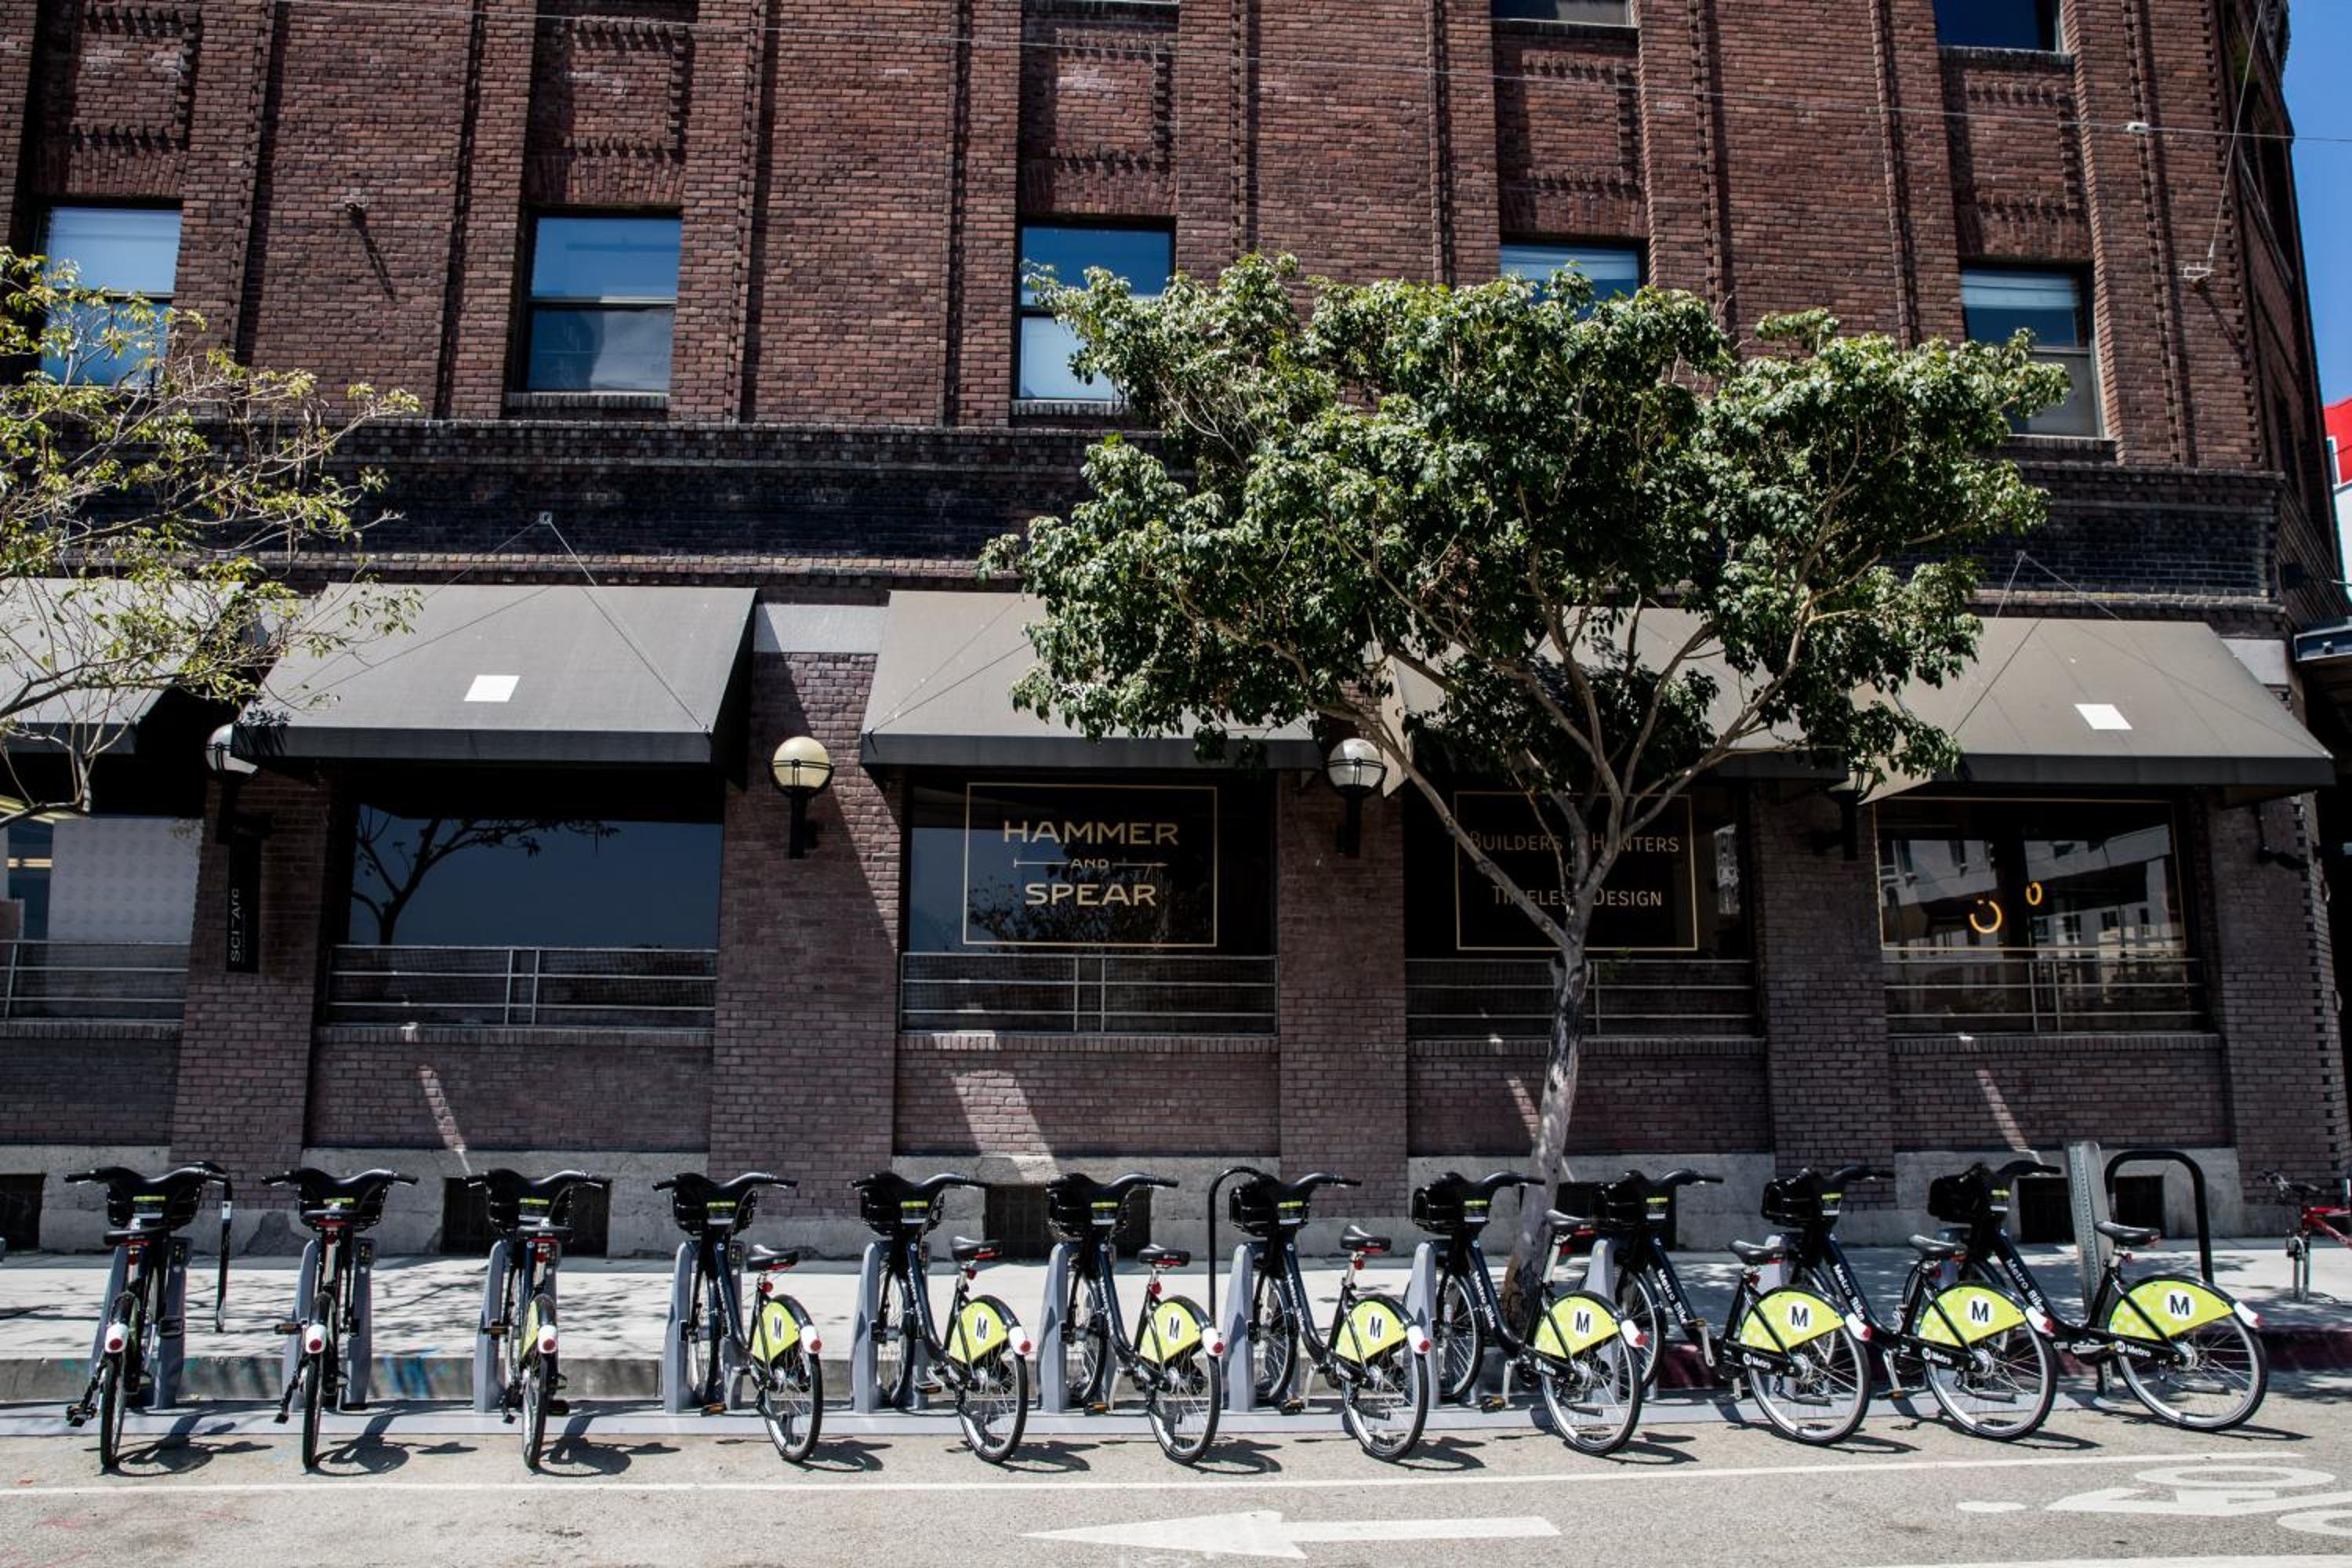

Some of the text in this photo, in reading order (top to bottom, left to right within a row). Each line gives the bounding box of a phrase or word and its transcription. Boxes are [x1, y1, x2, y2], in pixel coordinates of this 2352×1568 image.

[1004, 820, 1180, 846] HAMMER
[1592, 833, 1680, 852] HNTERS
[1070, 858, 1110, 869] AND
[1025, 883, 1157, 906] SPEAR
[1592, 887, 1663, 907] DESIGN
[1657, 1268, 1676, 1301] Metro
[1833, 1263, 1865, 1321] Metro Bike
[2005, 1258, 2045, 1313] Metro Bike
[1791, 1305, 1808, 1327] M
[1972, 1301, 1989, 1323] M
[2170, 1294, 2190, 1316] M
[976, 1316, 987, 1340] M
[1169, 1316, 1180, 1340] M
[1370, 1316, 1382, 1338] M
[1575, 1311, 1590, 1333] M
[2127, 1345, 2152, 1357] Metro
